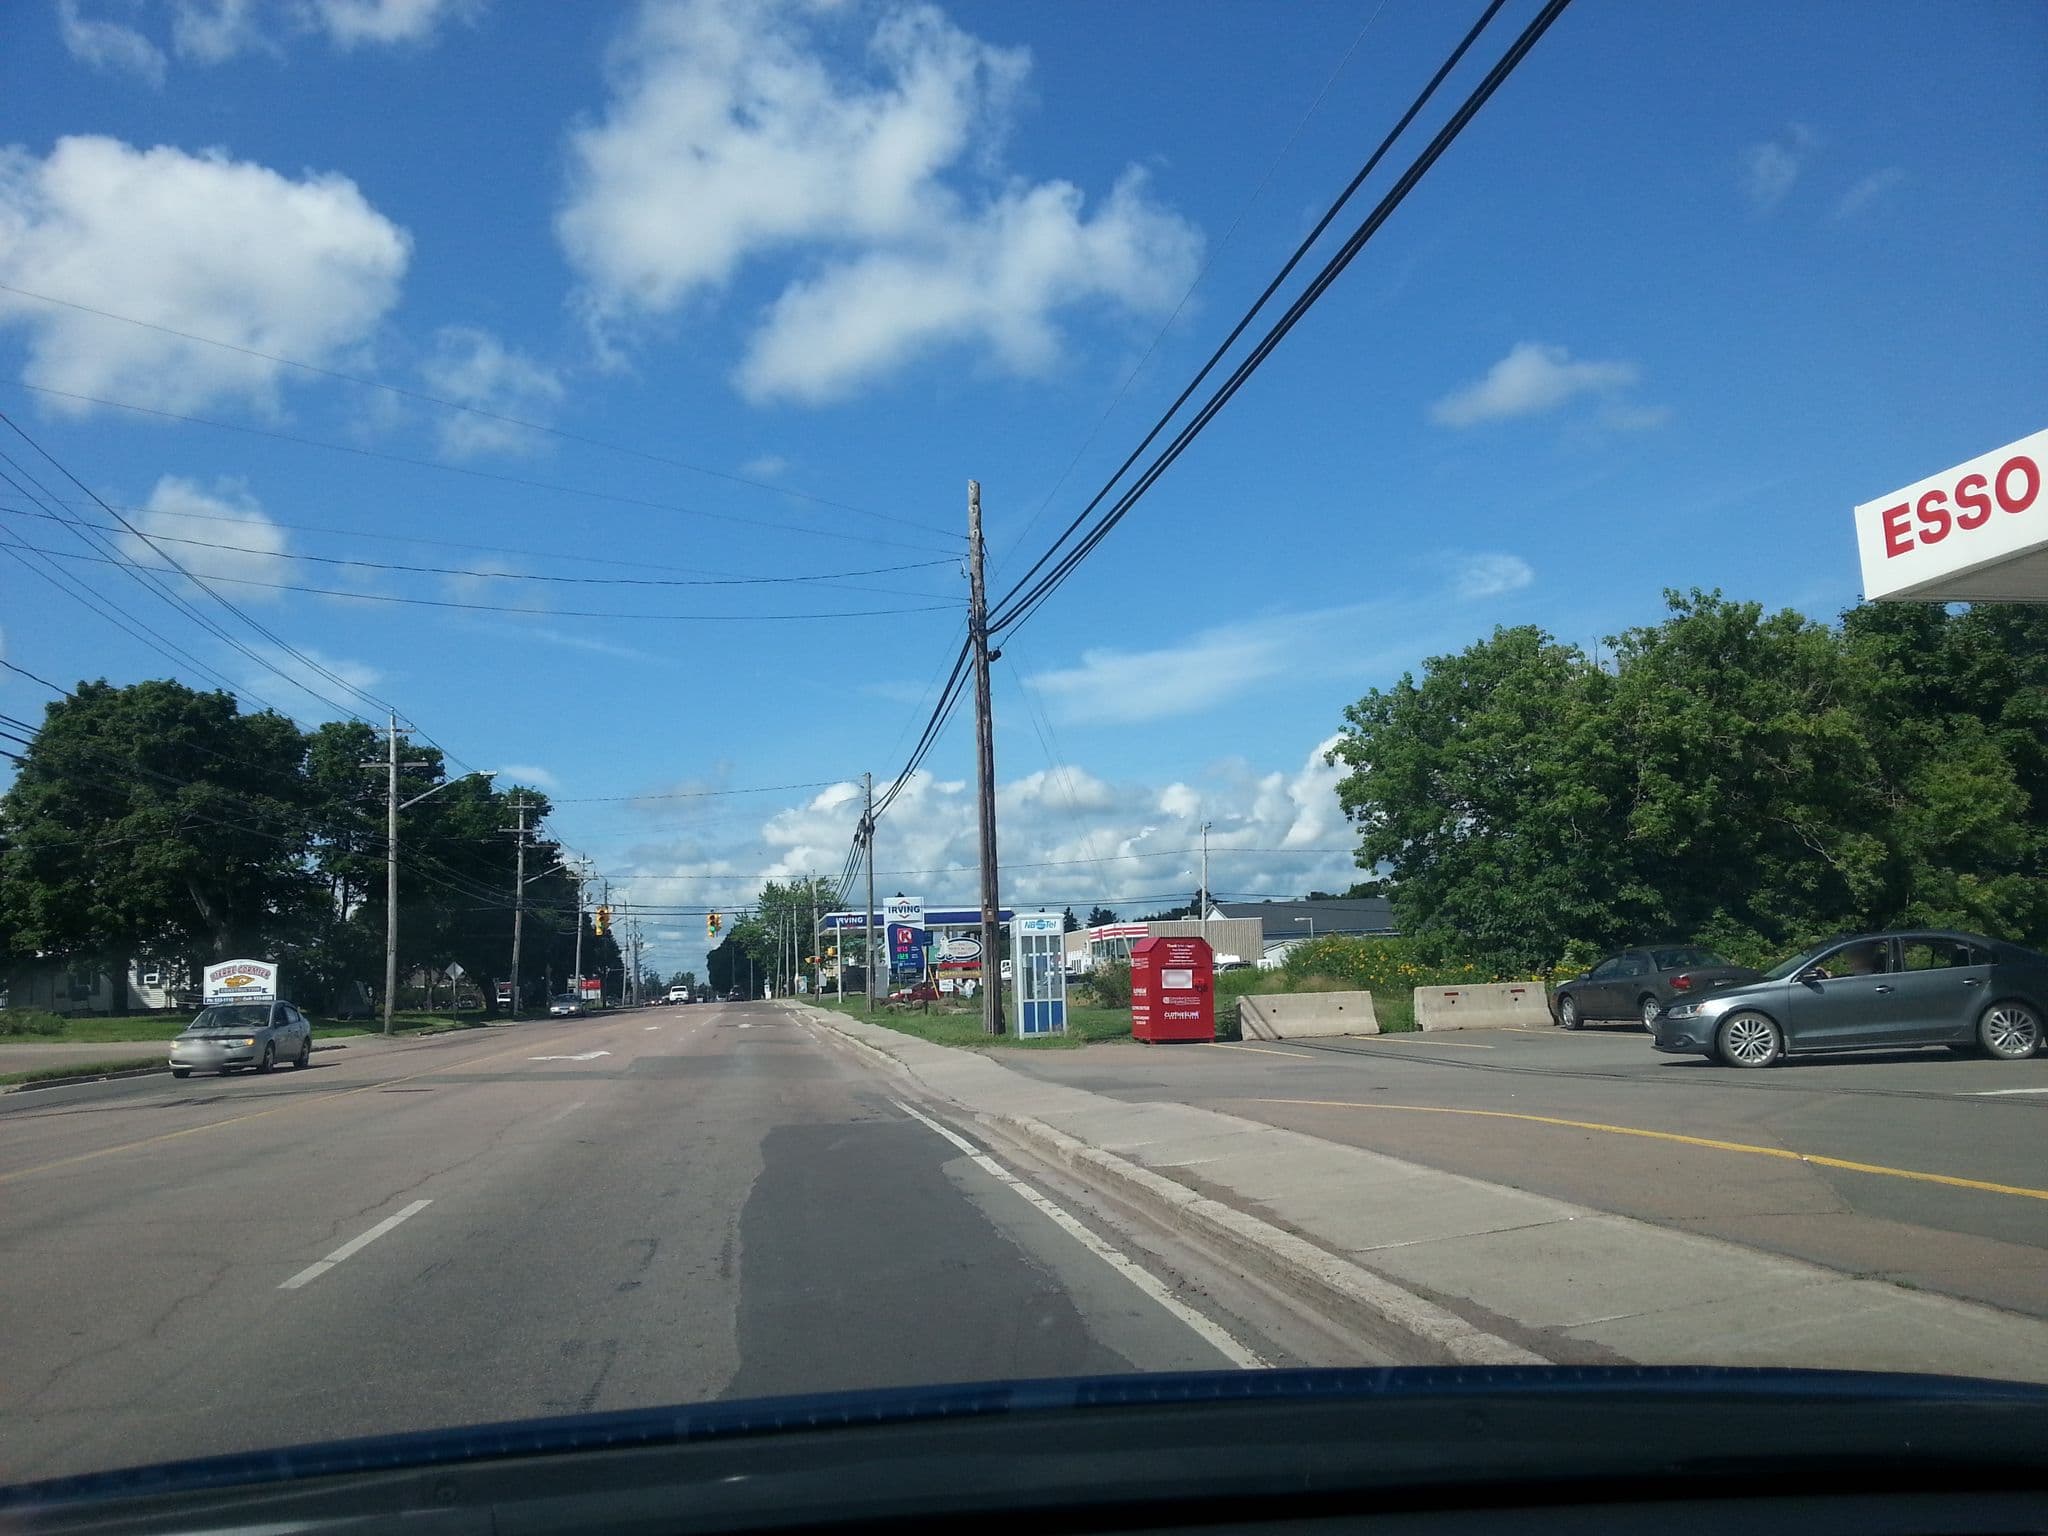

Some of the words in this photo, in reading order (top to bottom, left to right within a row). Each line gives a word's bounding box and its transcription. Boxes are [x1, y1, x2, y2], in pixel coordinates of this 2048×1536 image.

[1882, 456, 2041, 559] ESSO
[888, 905, 920, 914] IRVING
[835, 917, 864, 925] IRVING
